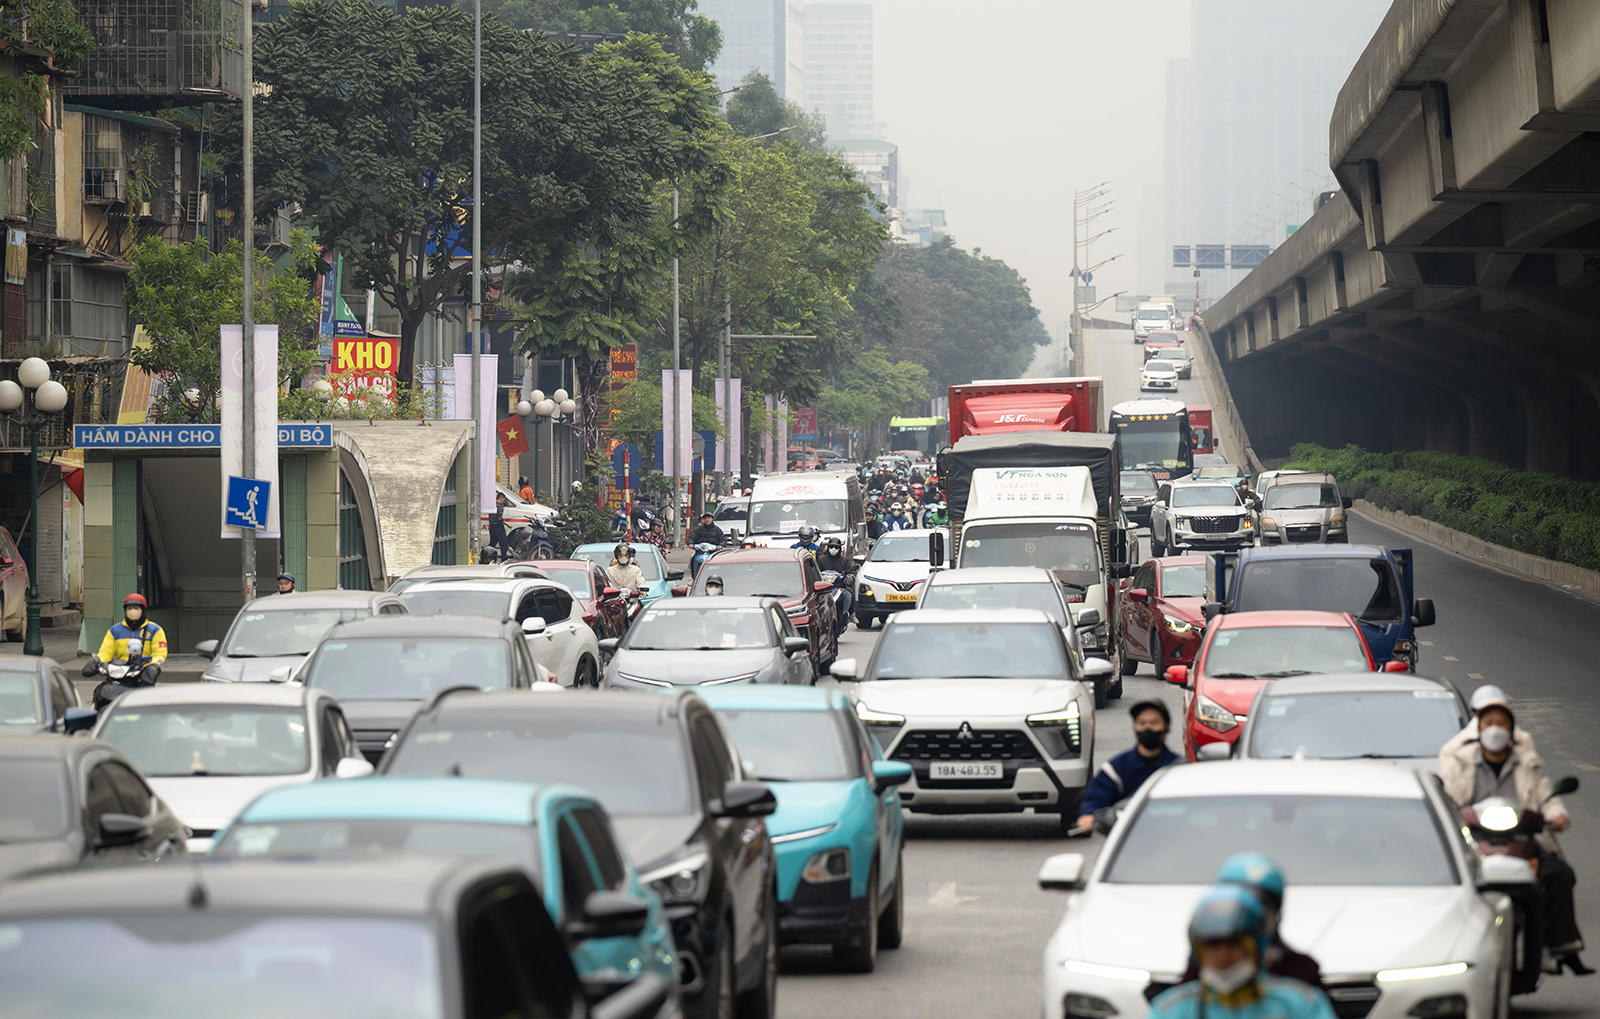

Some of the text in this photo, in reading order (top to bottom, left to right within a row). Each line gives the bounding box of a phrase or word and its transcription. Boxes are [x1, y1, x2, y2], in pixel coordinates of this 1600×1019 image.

[338, 341, 392, 369] KHO
[994, 414, 1027, 423] J&T
[81, 427, 120, 443] HẦM
[124, 427, 173, 443] DÀNH
[177, 430, 215, 443] CHO
[299, 427, 325, 445] BỘ
[996, 492, 1064, 501] TRUCKS
[937, 765, 997, 776] 18A-483.55
